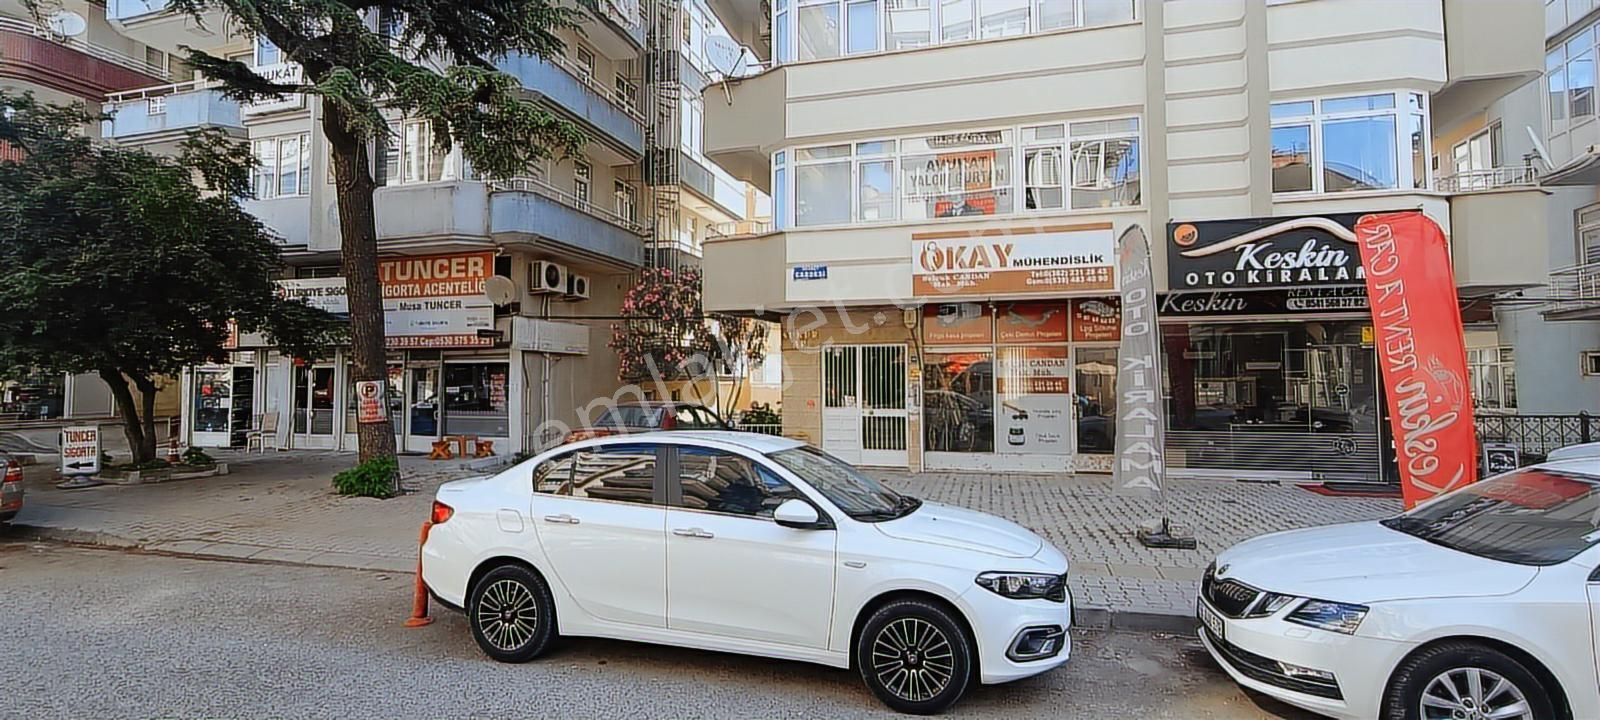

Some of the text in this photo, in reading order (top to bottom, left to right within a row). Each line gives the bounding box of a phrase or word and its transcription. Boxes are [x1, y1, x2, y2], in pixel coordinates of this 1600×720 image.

[1012, 254, 1104, 267] MÜHENDİSLİK
[1235, 239, 1349, 271] Keskin
[381, 256, 484, 281] TUNCER
[1185, 266, 1367, 286] OTO KiRALAM
[424, 300, 462, 310] TUNCER
[1160, 291, 1248, 313] Keskin
